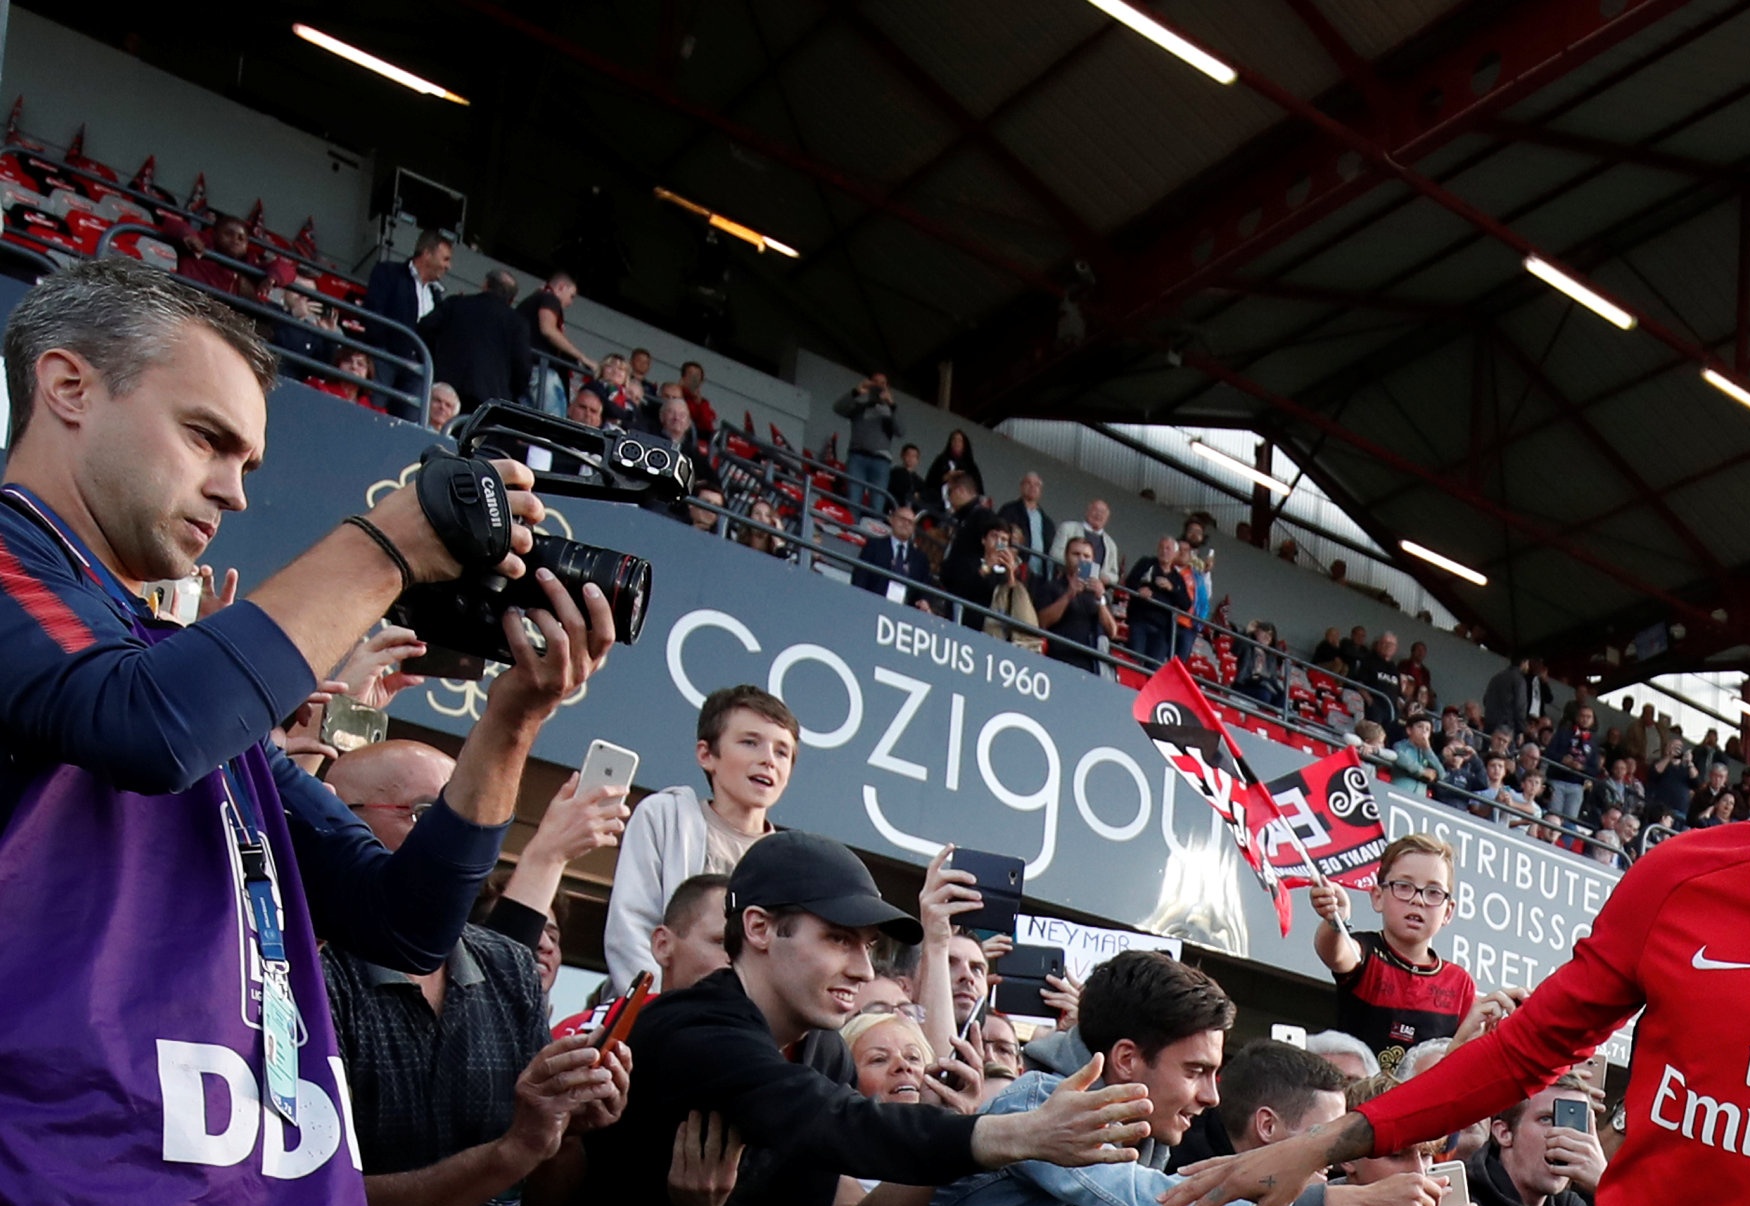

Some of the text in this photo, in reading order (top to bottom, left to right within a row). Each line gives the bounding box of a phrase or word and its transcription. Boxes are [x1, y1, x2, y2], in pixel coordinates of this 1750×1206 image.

[481, 476, 502, 528] Canon
[876, 614, 1051, 701] DEPUIS 1960
[1387, 805, 1614, 915] DISTRIBUTE
[1452, 934, 1556, 991] BRET
[156, 1039, 363, 1180] DD
